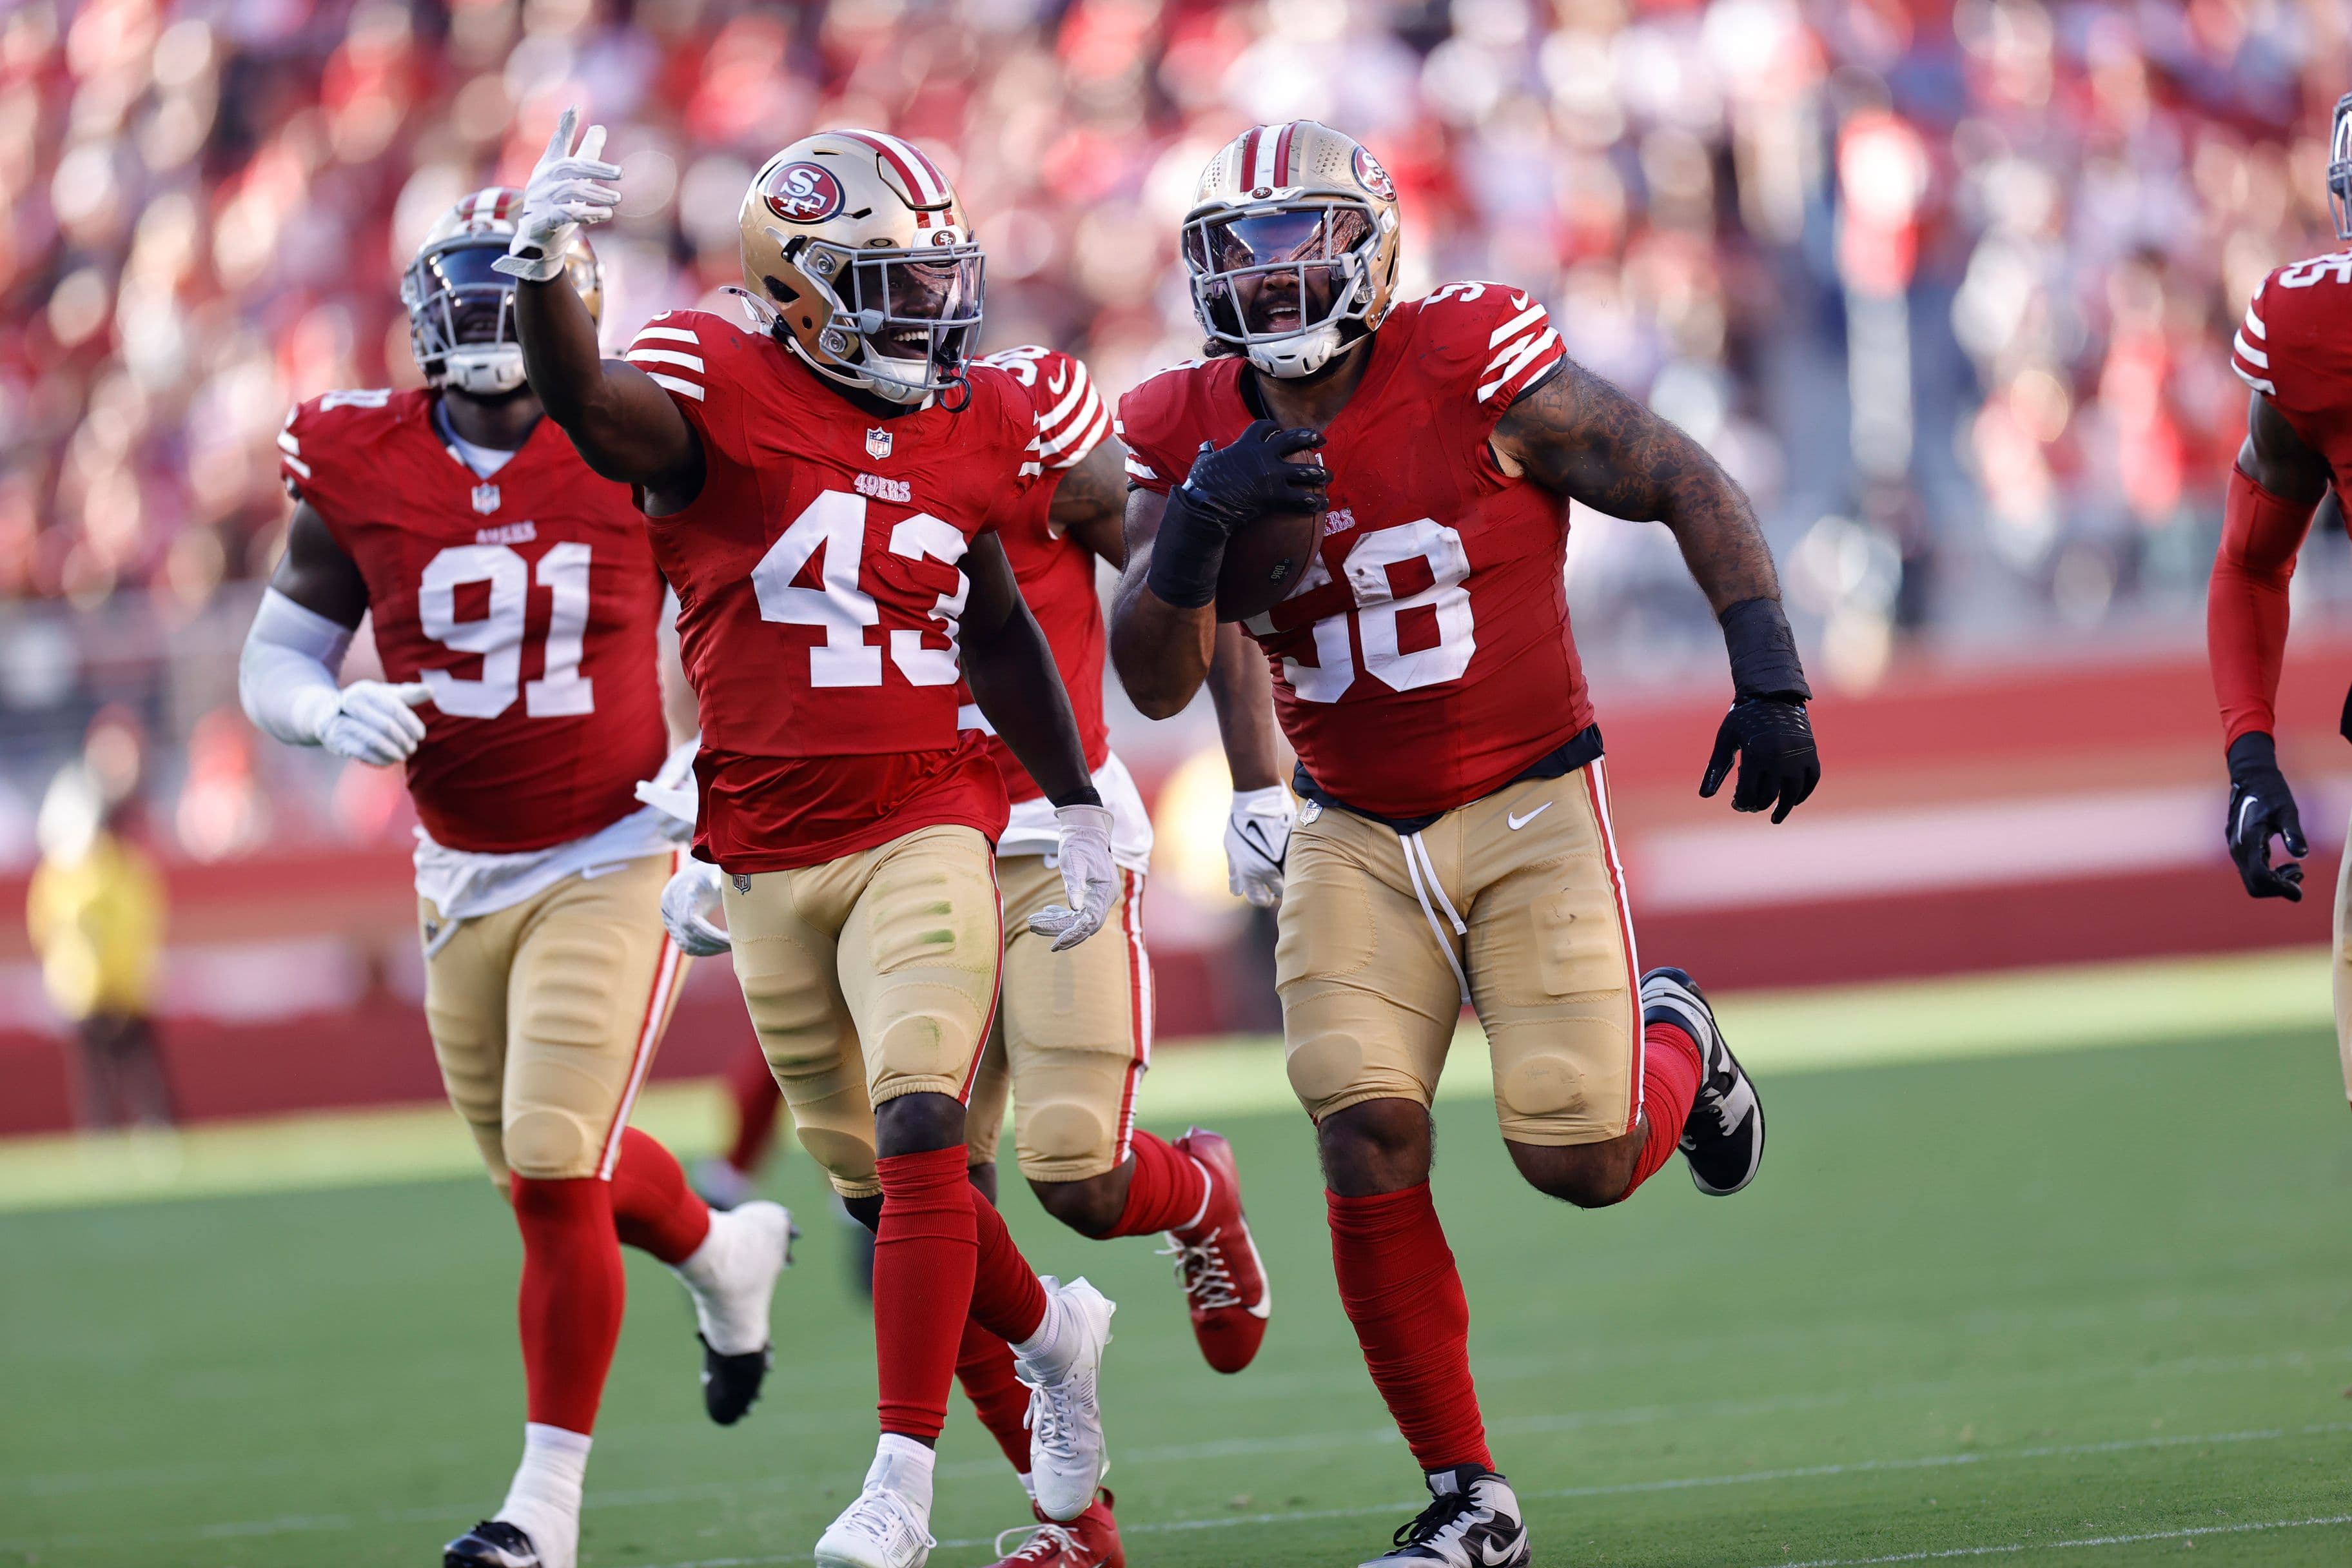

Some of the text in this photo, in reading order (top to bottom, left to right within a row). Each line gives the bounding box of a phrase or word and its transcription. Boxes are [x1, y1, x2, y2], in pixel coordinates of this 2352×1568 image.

[870, 440, 888, 454] NFL
[854, 472, 912, 503] 49ERS
[750, 489, 970, 688] 43
[418, 542, 595, 720] 91
[734, 874, 747, 888] NFL
